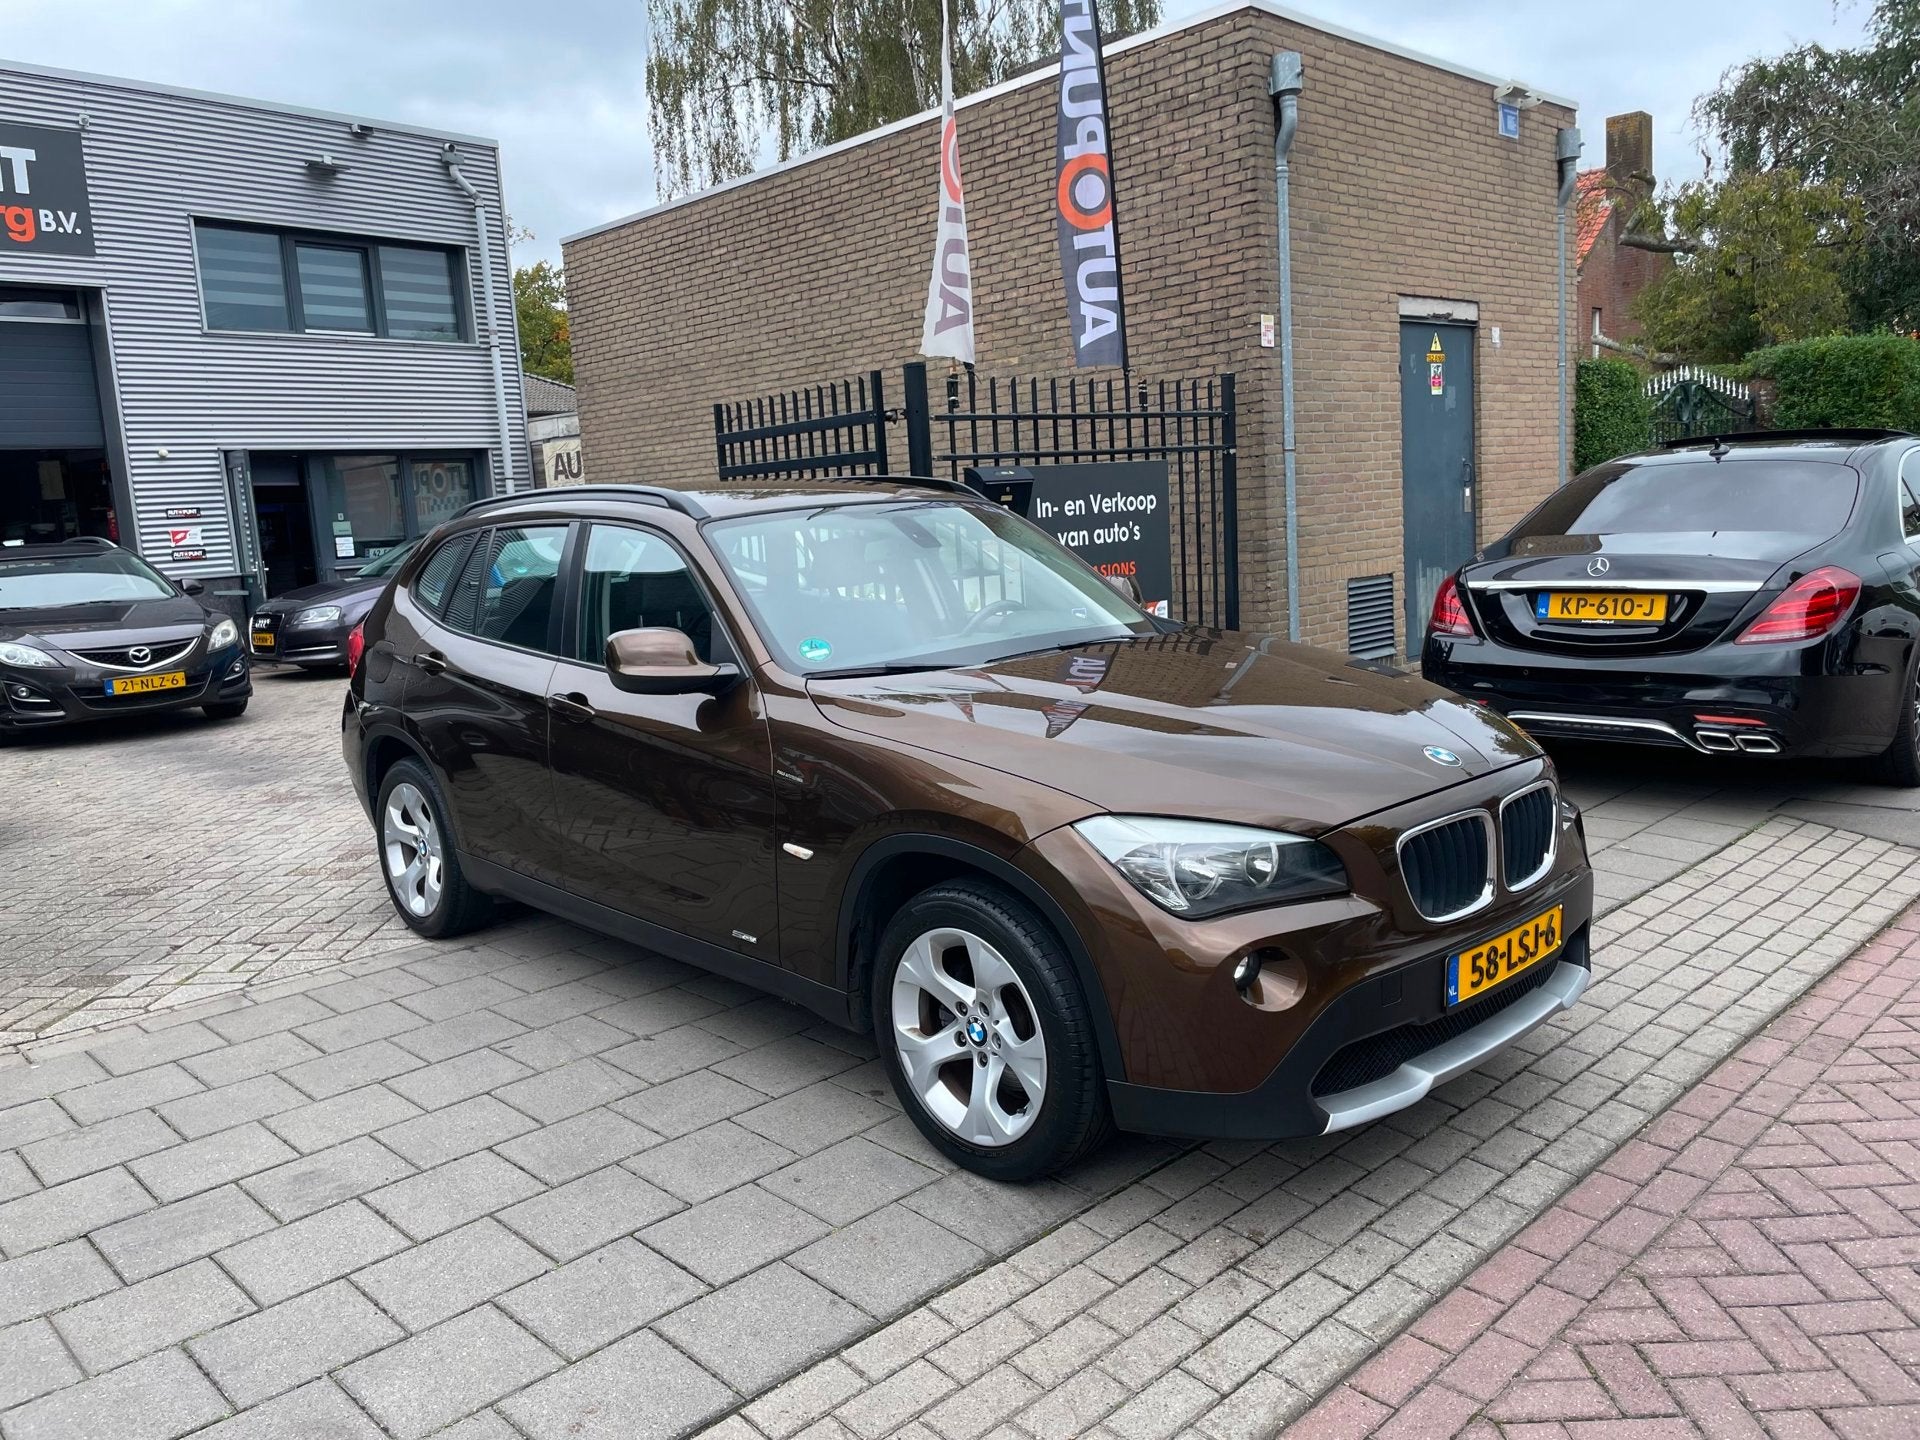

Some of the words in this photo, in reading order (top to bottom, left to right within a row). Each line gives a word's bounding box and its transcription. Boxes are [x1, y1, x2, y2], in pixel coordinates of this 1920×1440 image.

[38, 208, 82, 235] B.V.
[1036, 497, 1059, 519] In-
[1064, 499, 1086, 517] en
[1089, 491, 1157, 515] Verkoop
[1057, 529, 1089, 547] van
[1093, 520, 1141, 545] auto's
[1560, 597, 1655, 617] KP-610-J
[121, 675, 180, 692] 21-NLZ-6
[1448, 985, 1458, 997] NL
[1470, 913, 1556, 988] 58-LSJ-6
